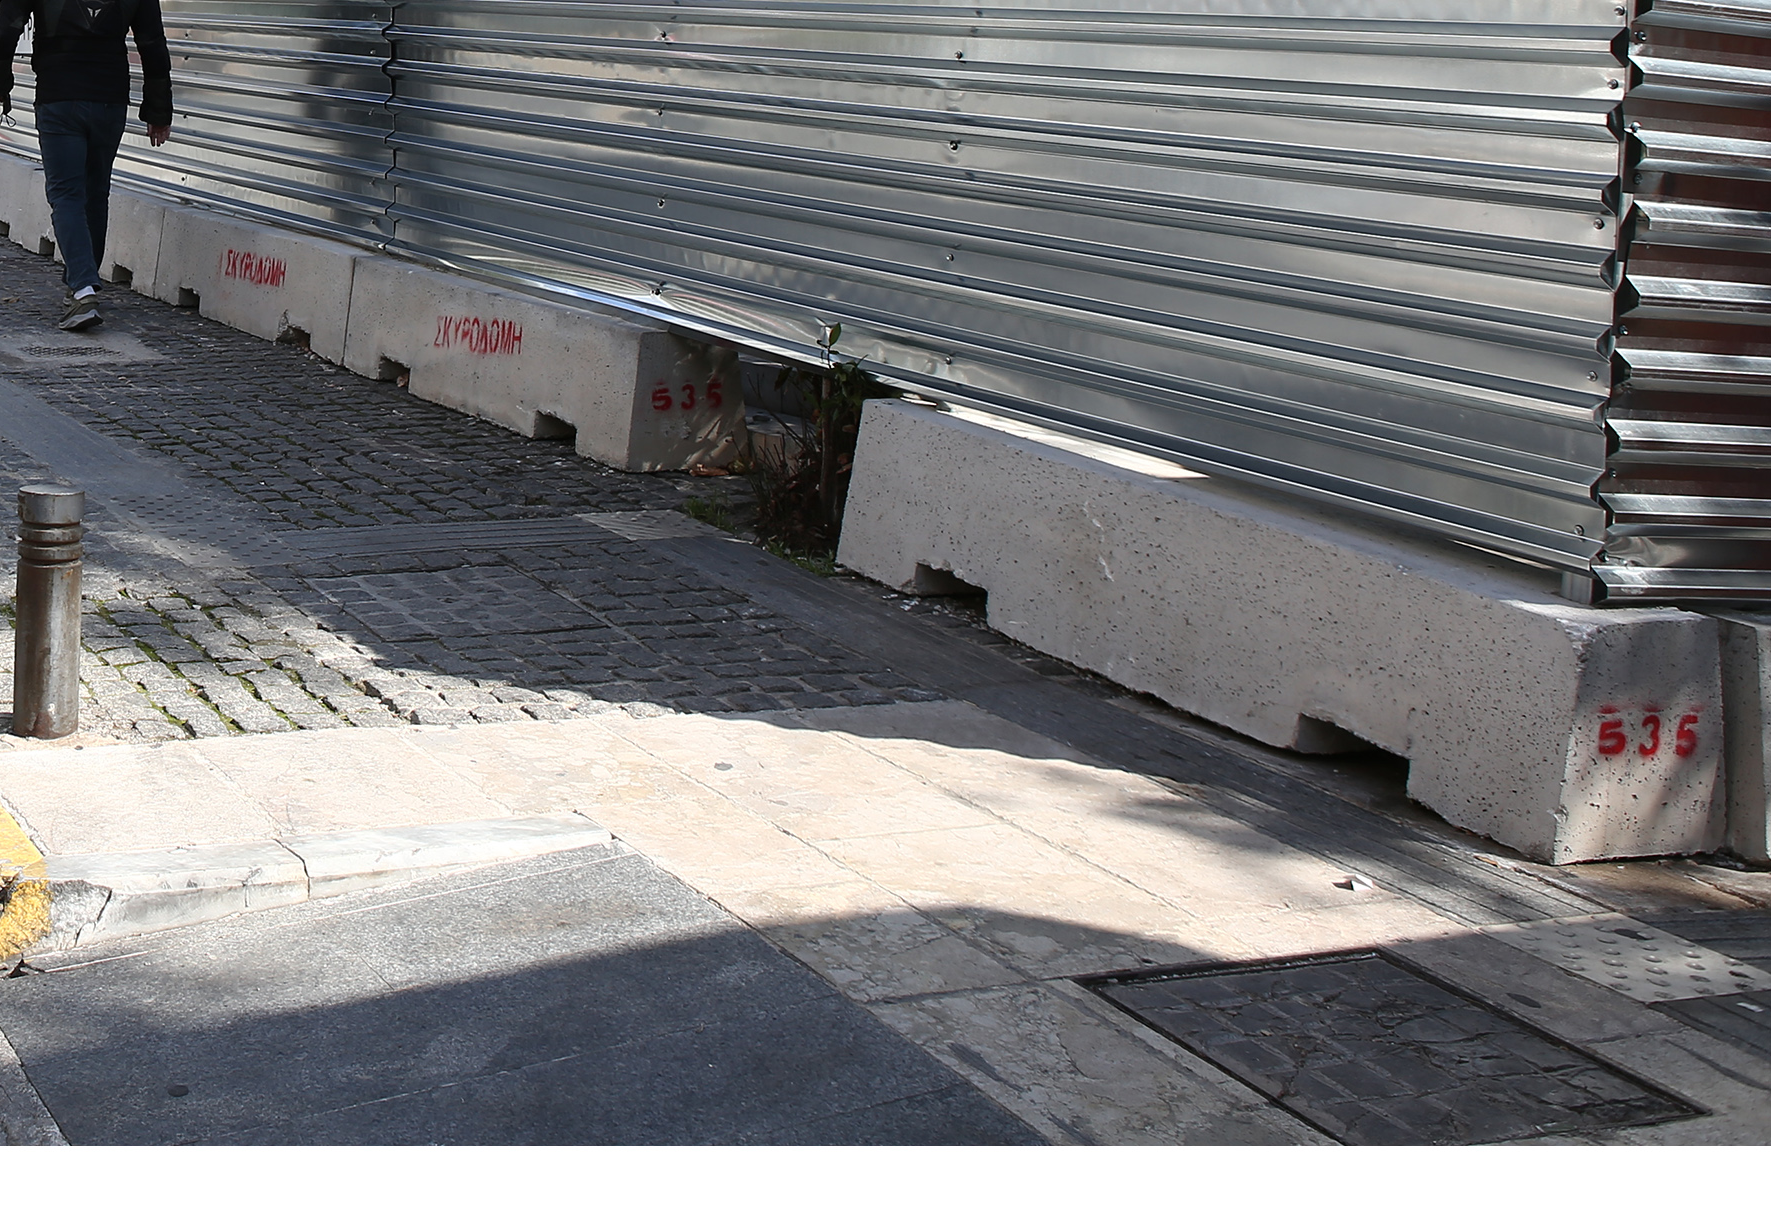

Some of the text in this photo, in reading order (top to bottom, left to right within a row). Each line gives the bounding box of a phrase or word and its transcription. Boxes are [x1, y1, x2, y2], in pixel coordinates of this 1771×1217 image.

[225, 249, 287, 288] ΣΚΥΡΟΔΟΜΗ
[433, 316, 523, 355] ΣΚΥΡΟΔΟΜΗ
[651, 381, 723, 412] 535
[1598, 713, 1700, 758] 535
